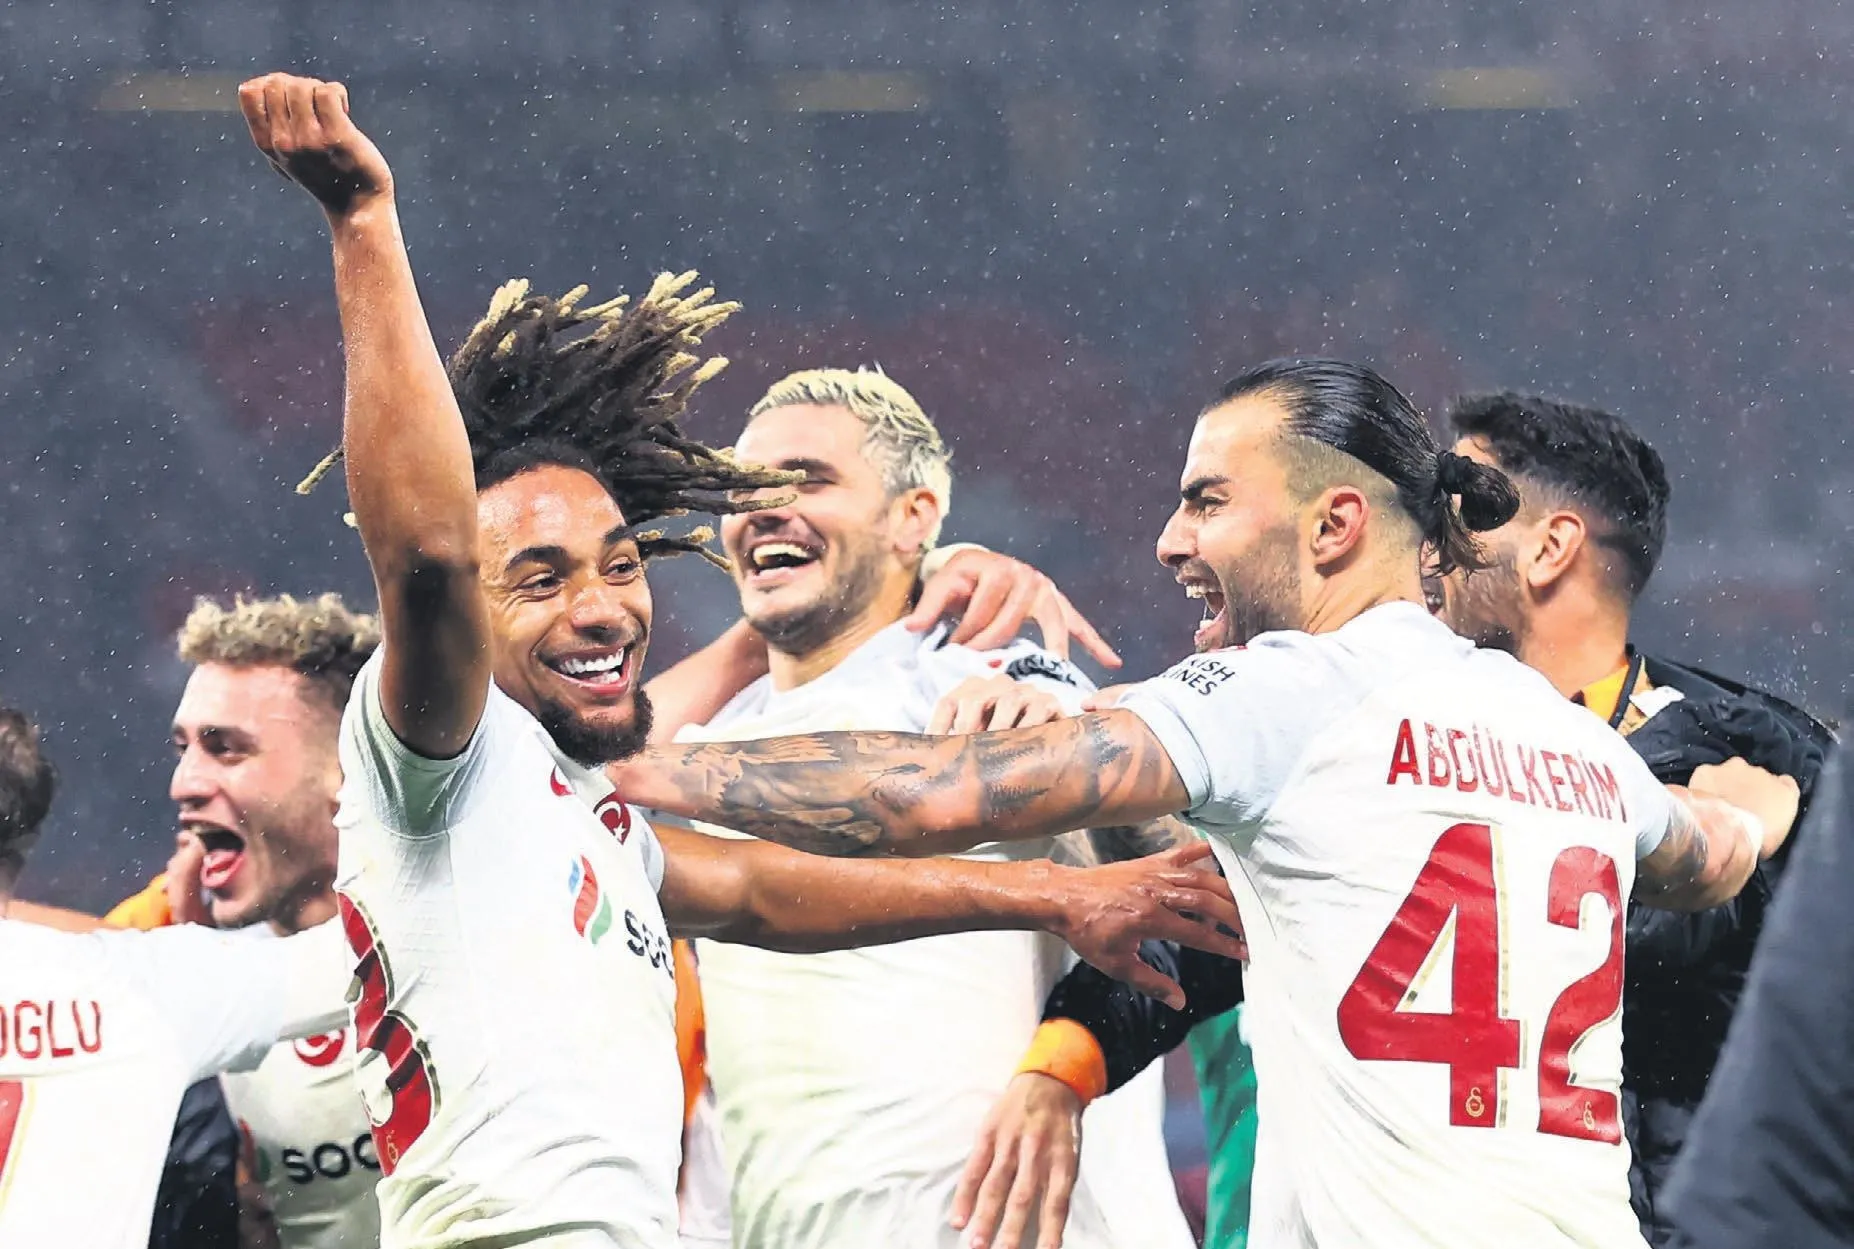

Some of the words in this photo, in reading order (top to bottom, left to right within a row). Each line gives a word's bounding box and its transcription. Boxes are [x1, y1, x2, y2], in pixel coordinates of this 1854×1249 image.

[1162, 668, 1218, 696] INES
[1189, 659, 1236, 682] ISH
[1337, 822, 1624, 1146] 42
